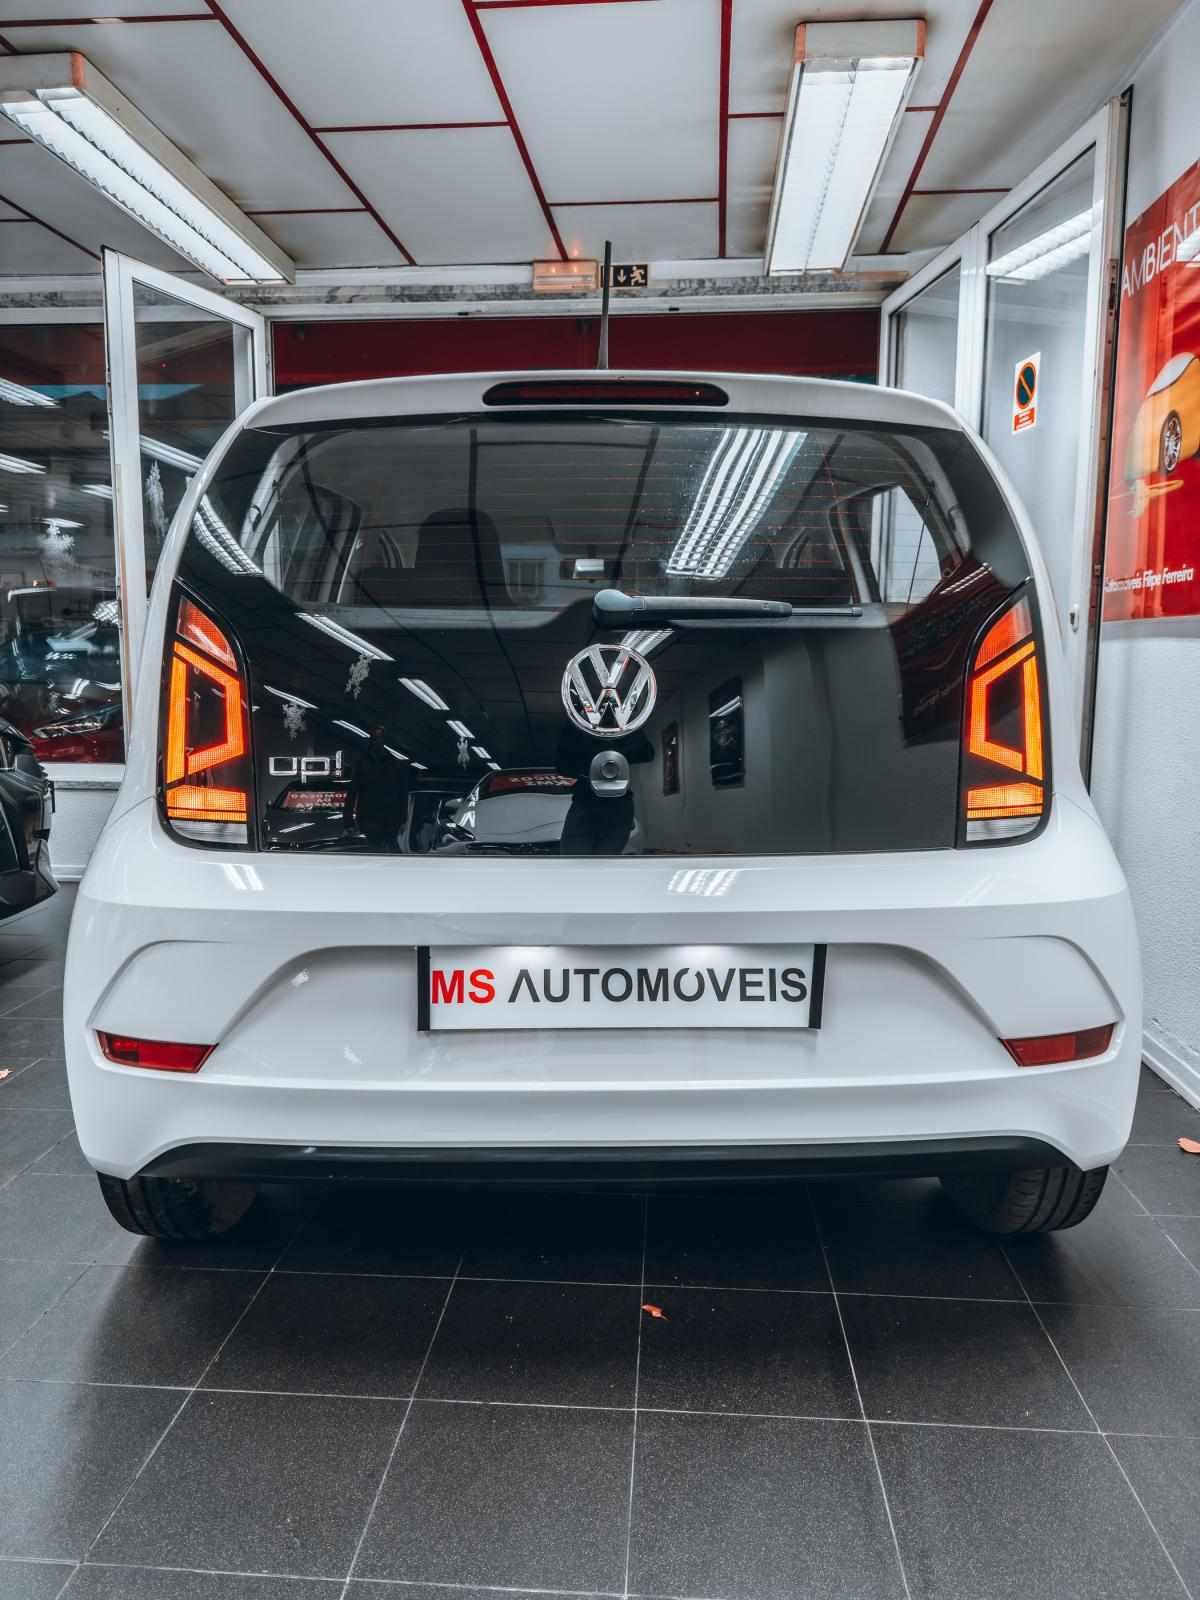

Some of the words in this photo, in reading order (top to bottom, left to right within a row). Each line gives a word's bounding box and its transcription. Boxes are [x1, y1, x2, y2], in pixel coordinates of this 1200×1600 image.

[1162, 563, 1194, 585] Ferreira
[269, 750, 343, 785] up!
[431, 968, 497, 1004] MS
